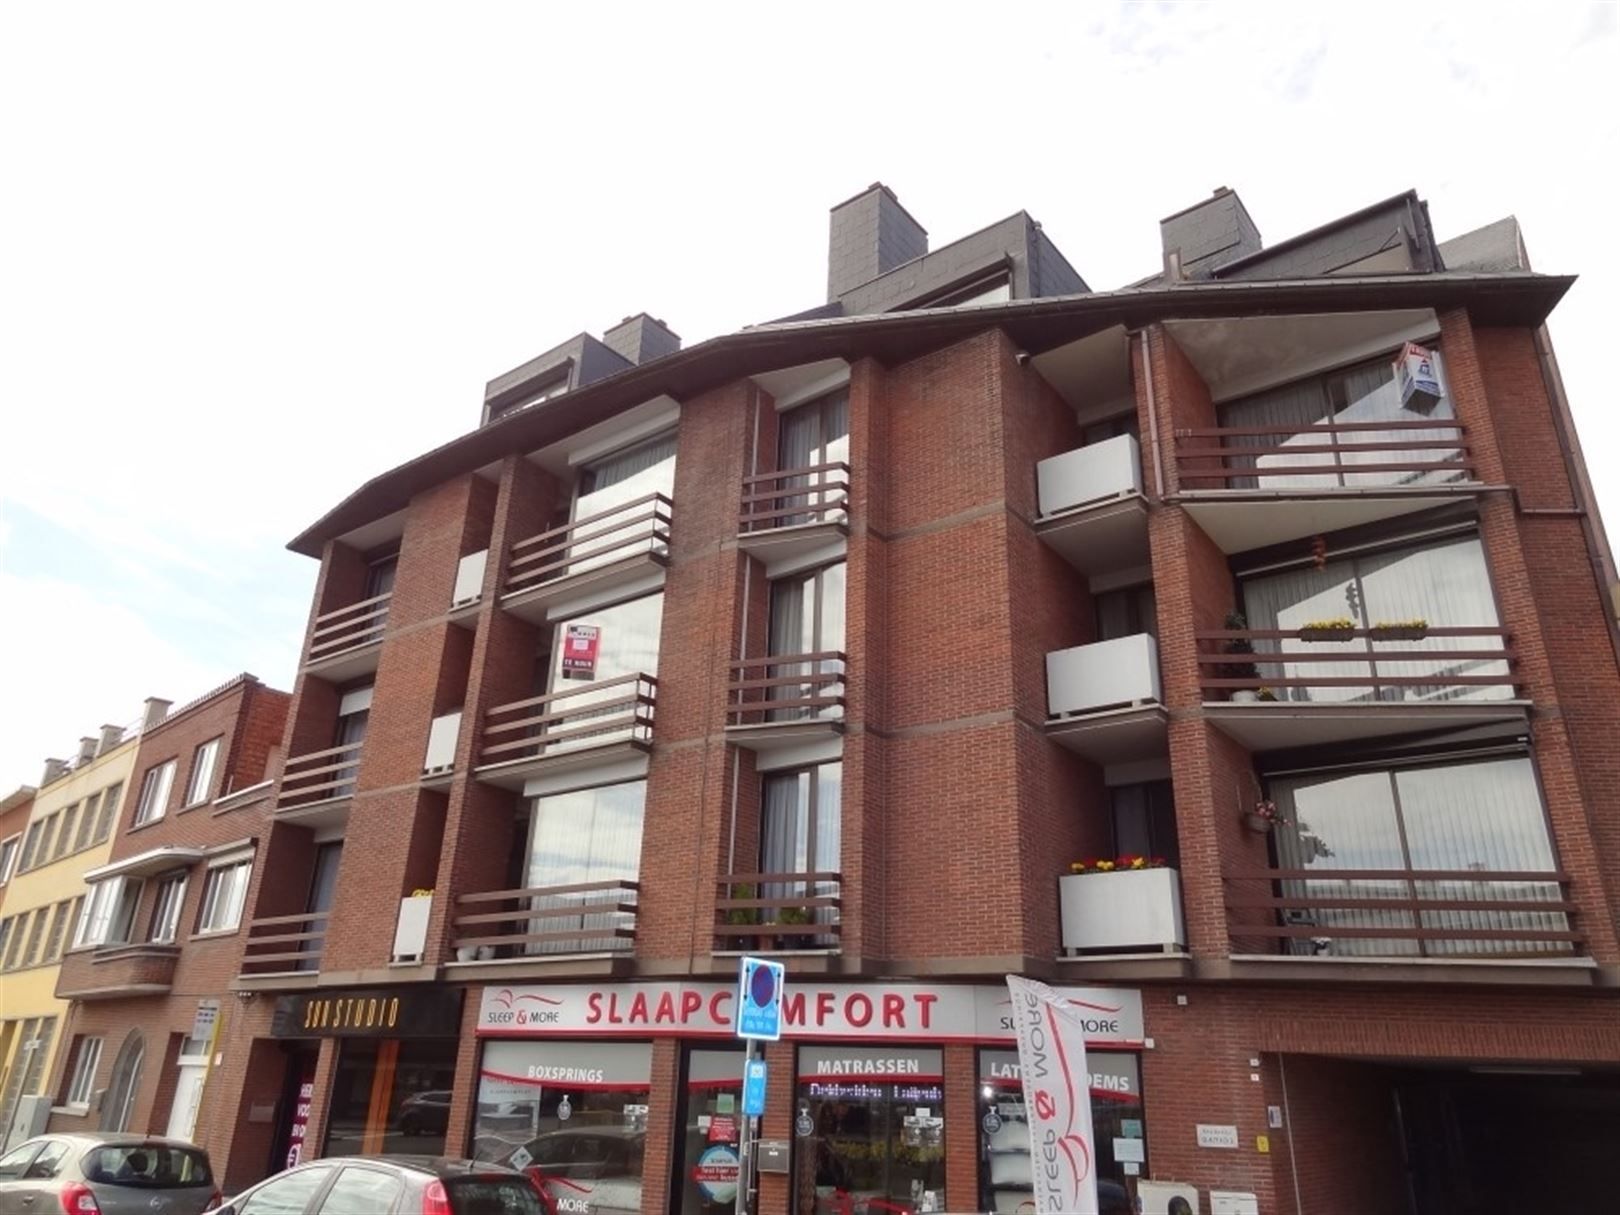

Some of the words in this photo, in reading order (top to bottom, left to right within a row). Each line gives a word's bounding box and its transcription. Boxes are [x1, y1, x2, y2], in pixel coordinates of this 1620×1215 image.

[333, 997, 399, 1027] STUDIO
[488, 1012, 514, 1023] SLEEP
[516, 1010, 527, 1024] &
[530, 1011, 559, 1023] MORE
[586, 991, 939, 1028] SLAAPCMFORT
[528, 1065, 604, 1083] BOXSPRINGS
[817, 1058, 919, 1075] MATRASSEN
[556, 1197, 590, 1214] MORE
